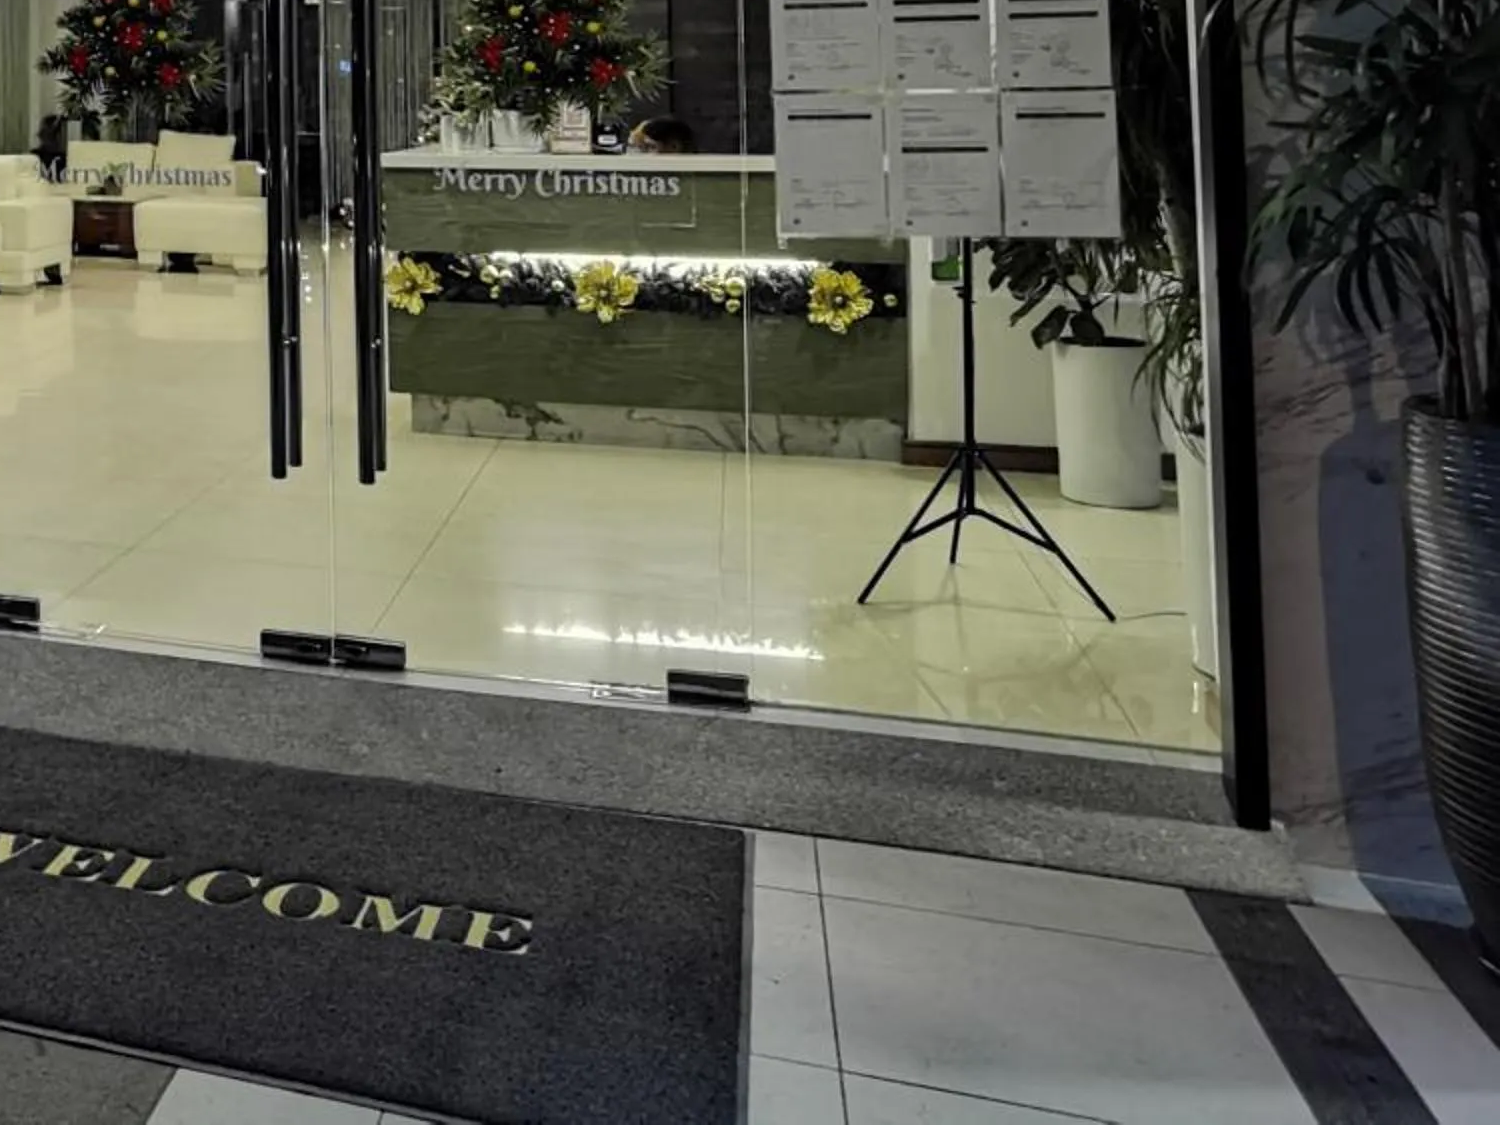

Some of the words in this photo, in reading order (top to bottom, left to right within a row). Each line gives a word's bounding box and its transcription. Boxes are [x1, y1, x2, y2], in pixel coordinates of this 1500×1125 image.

[36, 156, 103, 188] Merry
[433, 166, 527, 200] Merry
[534, 165, 681, 197] Christmas
